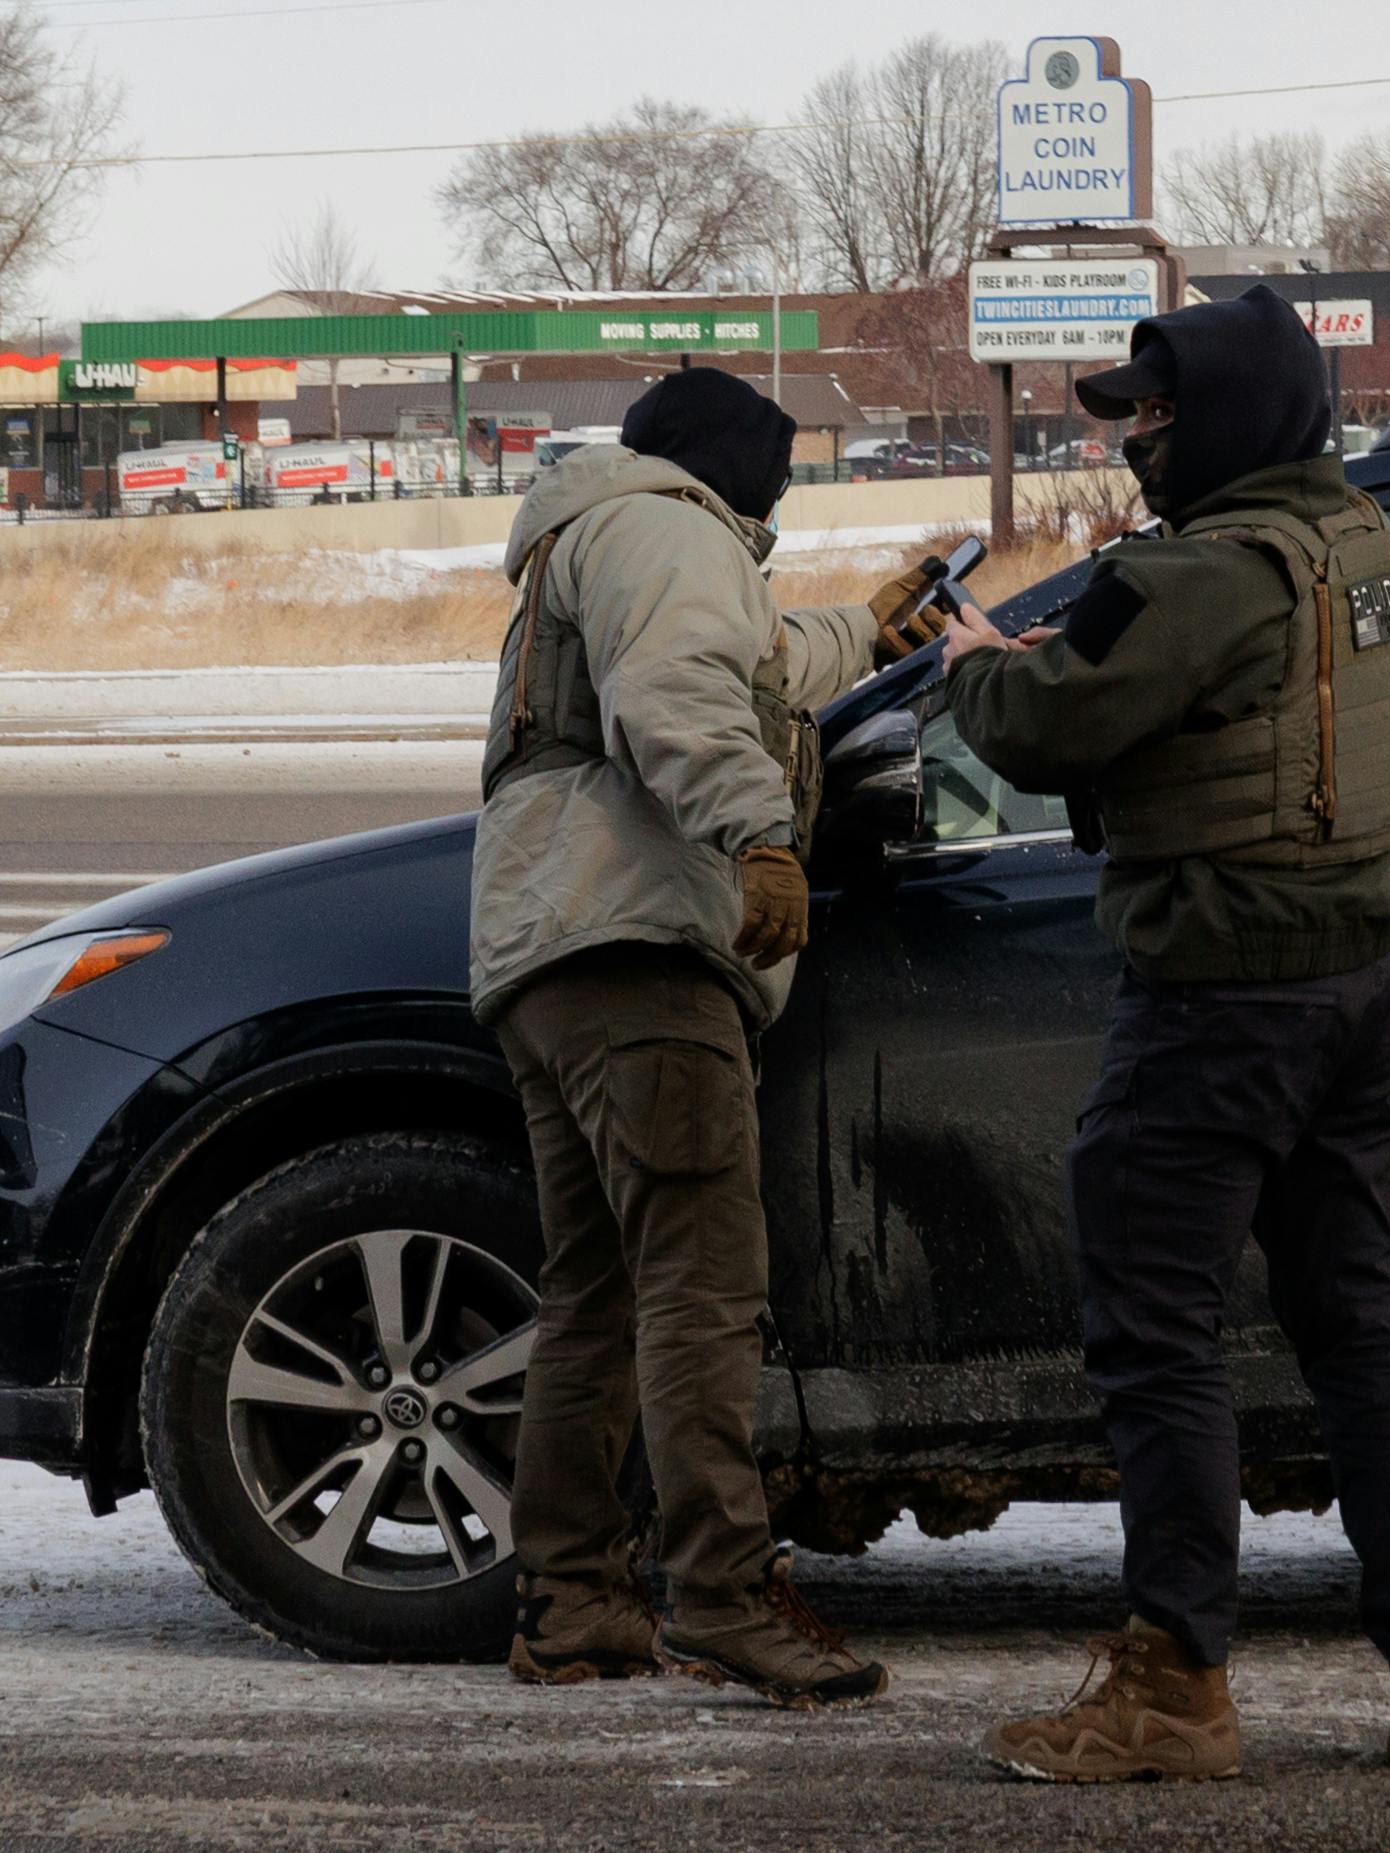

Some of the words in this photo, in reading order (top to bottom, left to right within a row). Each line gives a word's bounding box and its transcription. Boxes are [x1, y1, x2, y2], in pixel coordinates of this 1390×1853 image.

[1012, 102, 1108, 125] METRO
[1034, 136, 1095, 158] COIN
[1005, 168, 1126, 192] LAUNDRY
[976, 275, 1002, 289] FREE
[1005, 275, 1033, 288] WI-FI
[1043, 274, 1067, 288] KIDS
[1070, 273, 1127, 288] PLAYROOM
[976, 298, 1150, 318] TWINCITIESLAUNDRY.COM
[600, 323, 644, 339] MOVING
[649, 322, 701, 339] SUPPLIES
[714, 322, 759, 339] HITCHES
[976, 331, 1003, 346] OPEN
[1007, 330, 1056, 346] EVERYDAY
[1098, 330, 1125, 344] 10PM
